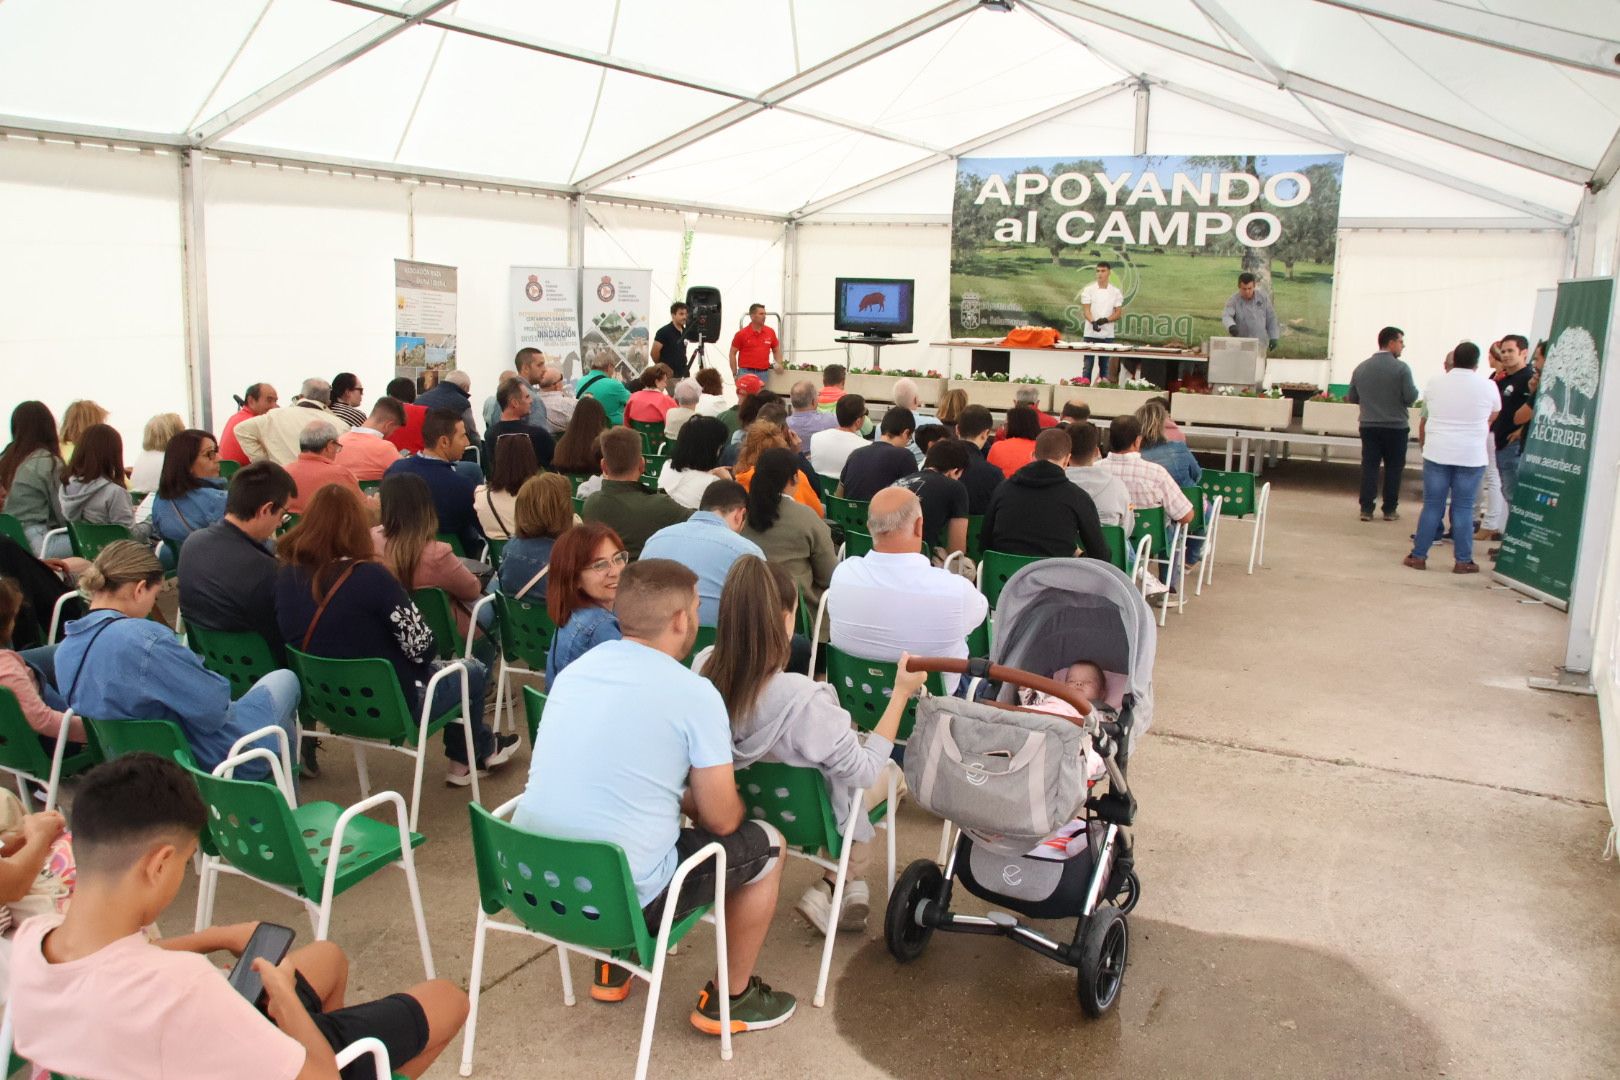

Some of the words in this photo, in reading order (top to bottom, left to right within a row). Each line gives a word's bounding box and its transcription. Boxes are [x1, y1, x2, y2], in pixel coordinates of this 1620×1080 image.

[974, 172, 1311, 208] APOYANDO
[994, 212, 1037, 244] al
[1056, 211, 1282, 248] CAMPO
[537, 328, 577, 339] INNOVACIÓN
[1530, 424, 1587, 449] AECERIBER
[1525, 453, 1582, 476] www.aeceriber.es
